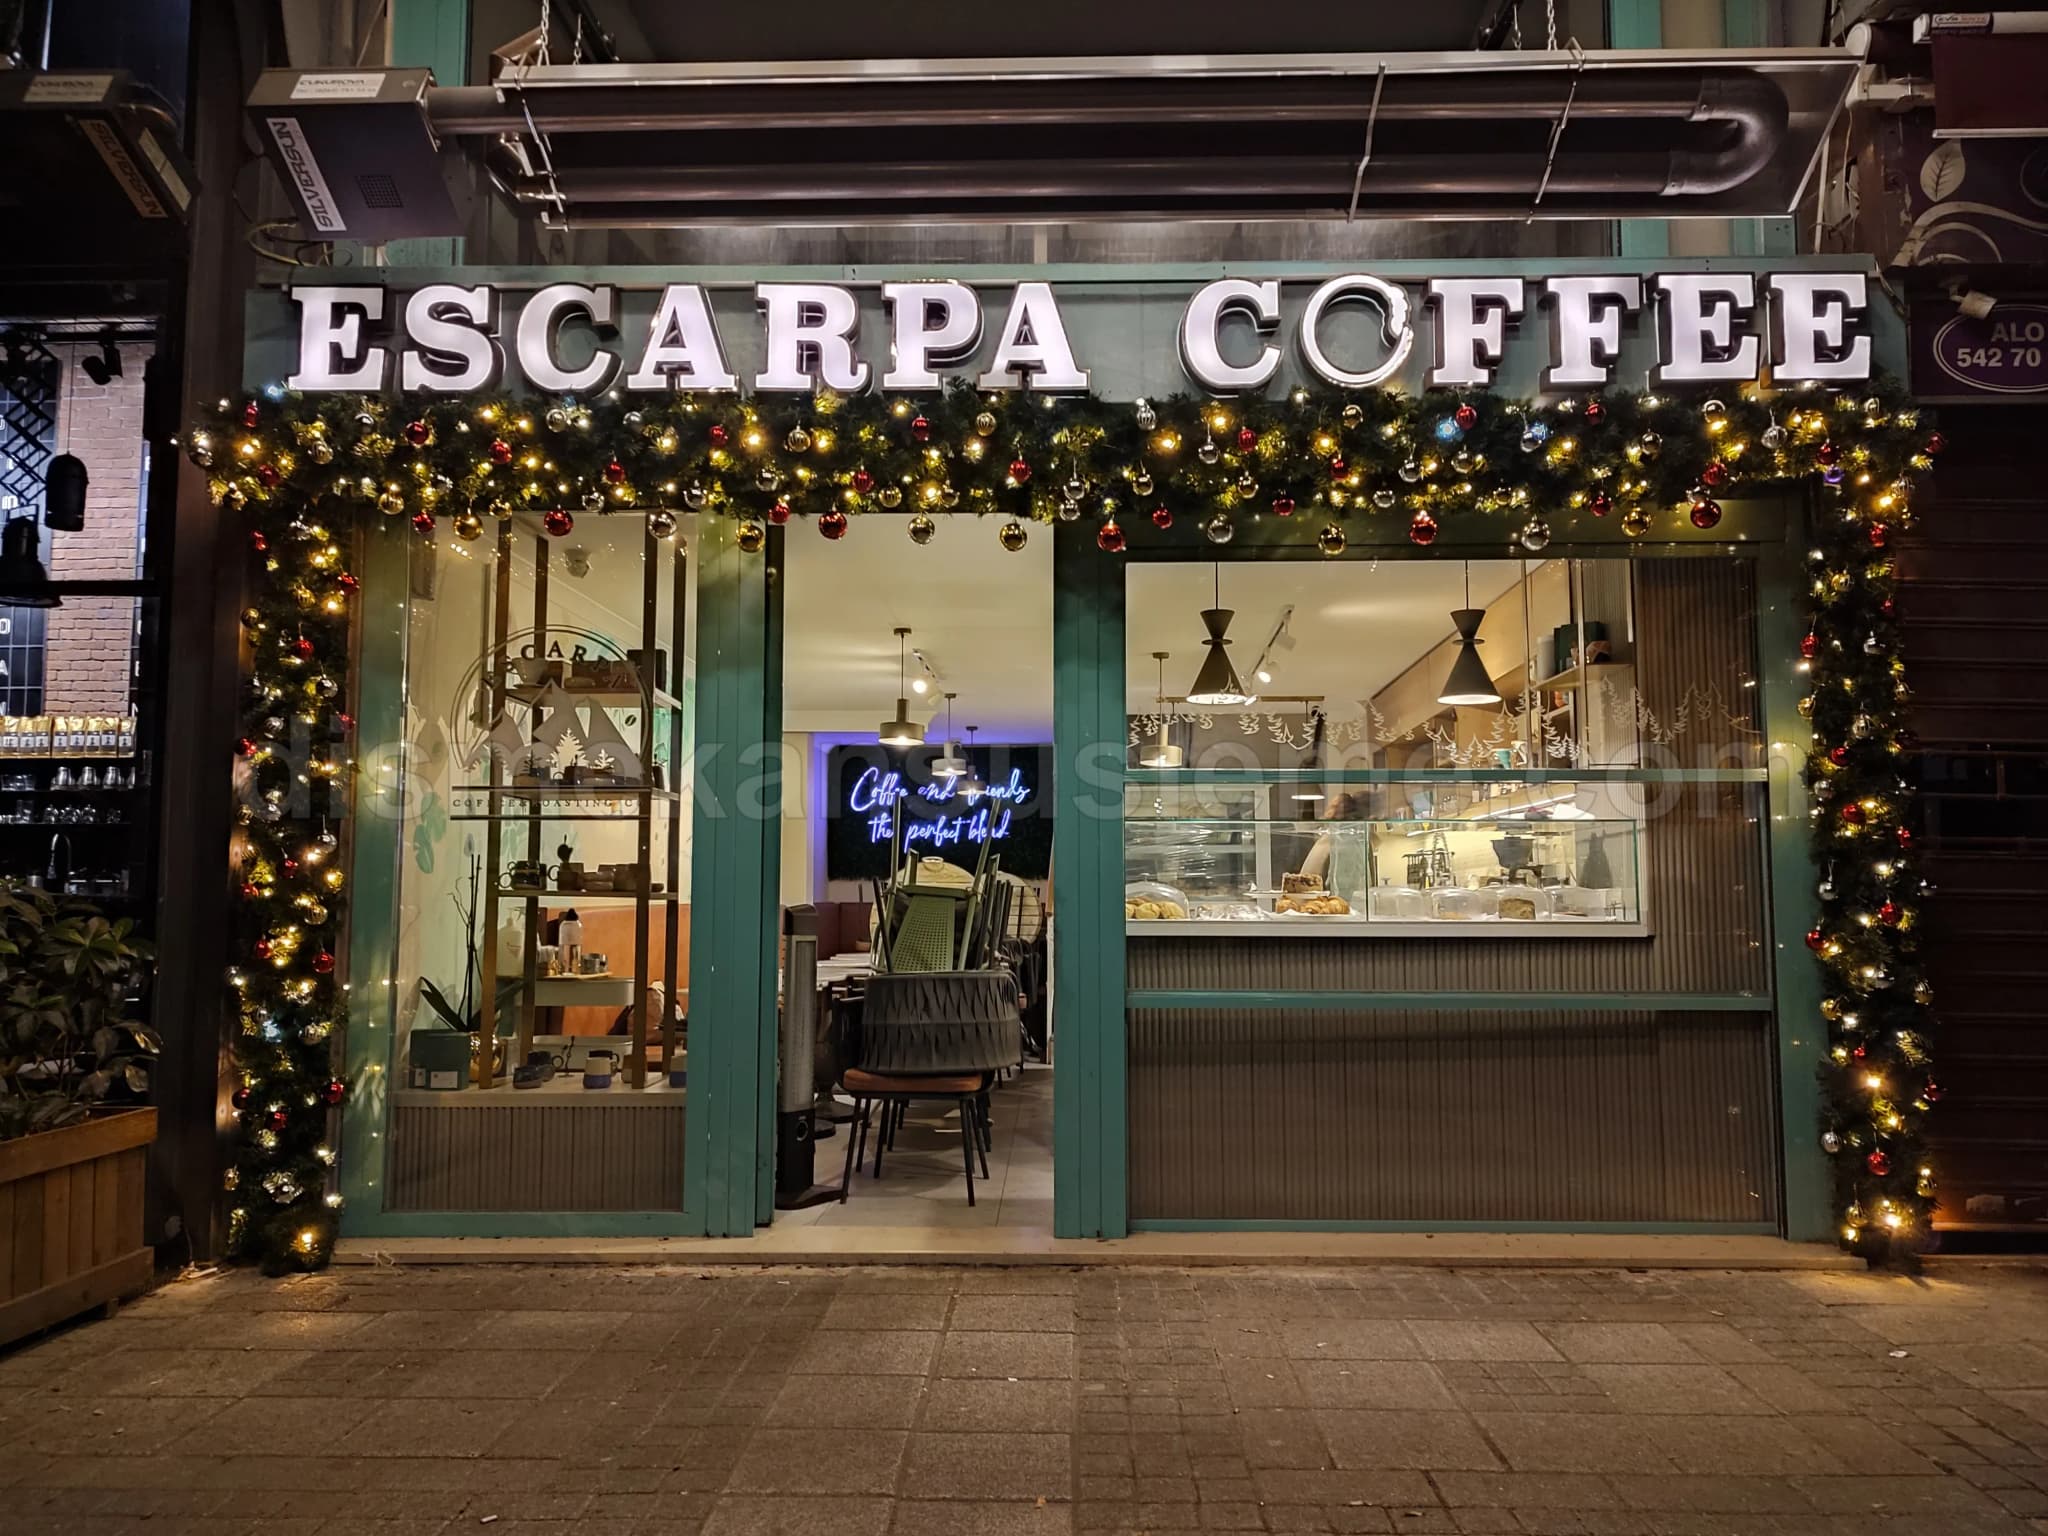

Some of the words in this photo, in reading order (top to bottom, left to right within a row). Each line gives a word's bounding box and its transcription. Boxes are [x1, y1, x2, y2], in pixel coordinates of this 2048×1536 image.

[272, 120, 334, 228] SILVERSUN
[287, 280, 1091, 393] ESCARPA
[1180, 272, 1873, 391] COFFEE
[1991, 321, 2045, 342] ALO
[1957, 347, 2003, 368] 542
[2010, 347, 2042, 368] 70
[917, 774, 957, 801] and
[867, 812, 895, 844] the
[903, 815, 971, 854] perfect
